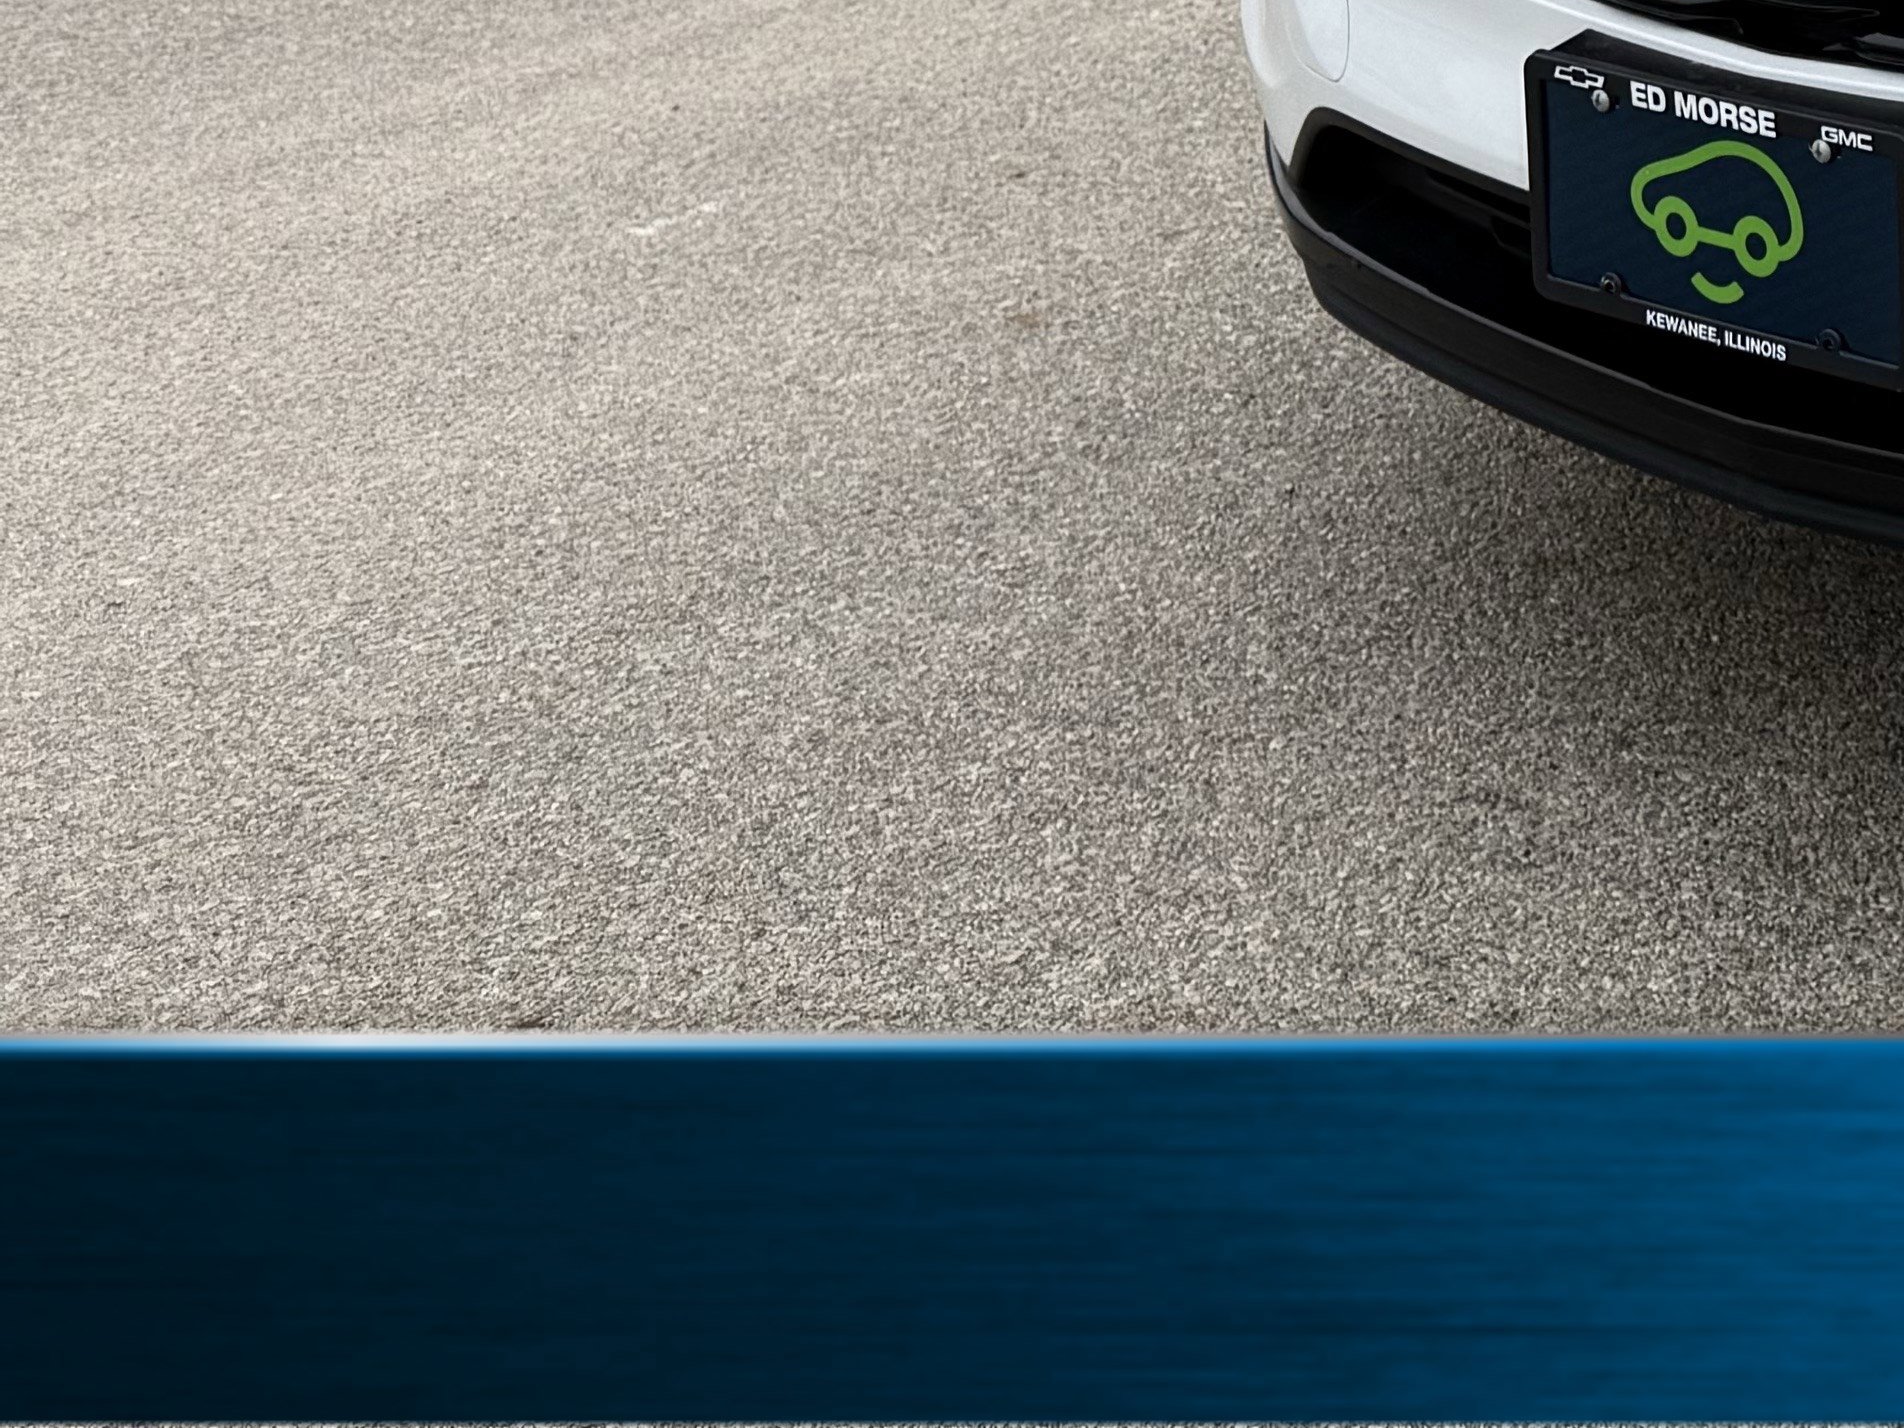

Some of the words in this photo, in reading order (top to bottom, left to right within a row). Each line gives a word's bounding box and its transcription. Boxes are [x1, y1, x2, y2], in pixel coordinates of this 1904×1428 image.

[1629, 80, 1667, 113] ED
[1674, 90, 1778, 139] MORSE
[1820, 125, 1874, 152] GMC
[1645, 309, 1722, 347] KEWANEE,
[1724, 329, 1787, 362] ILLINOIS
